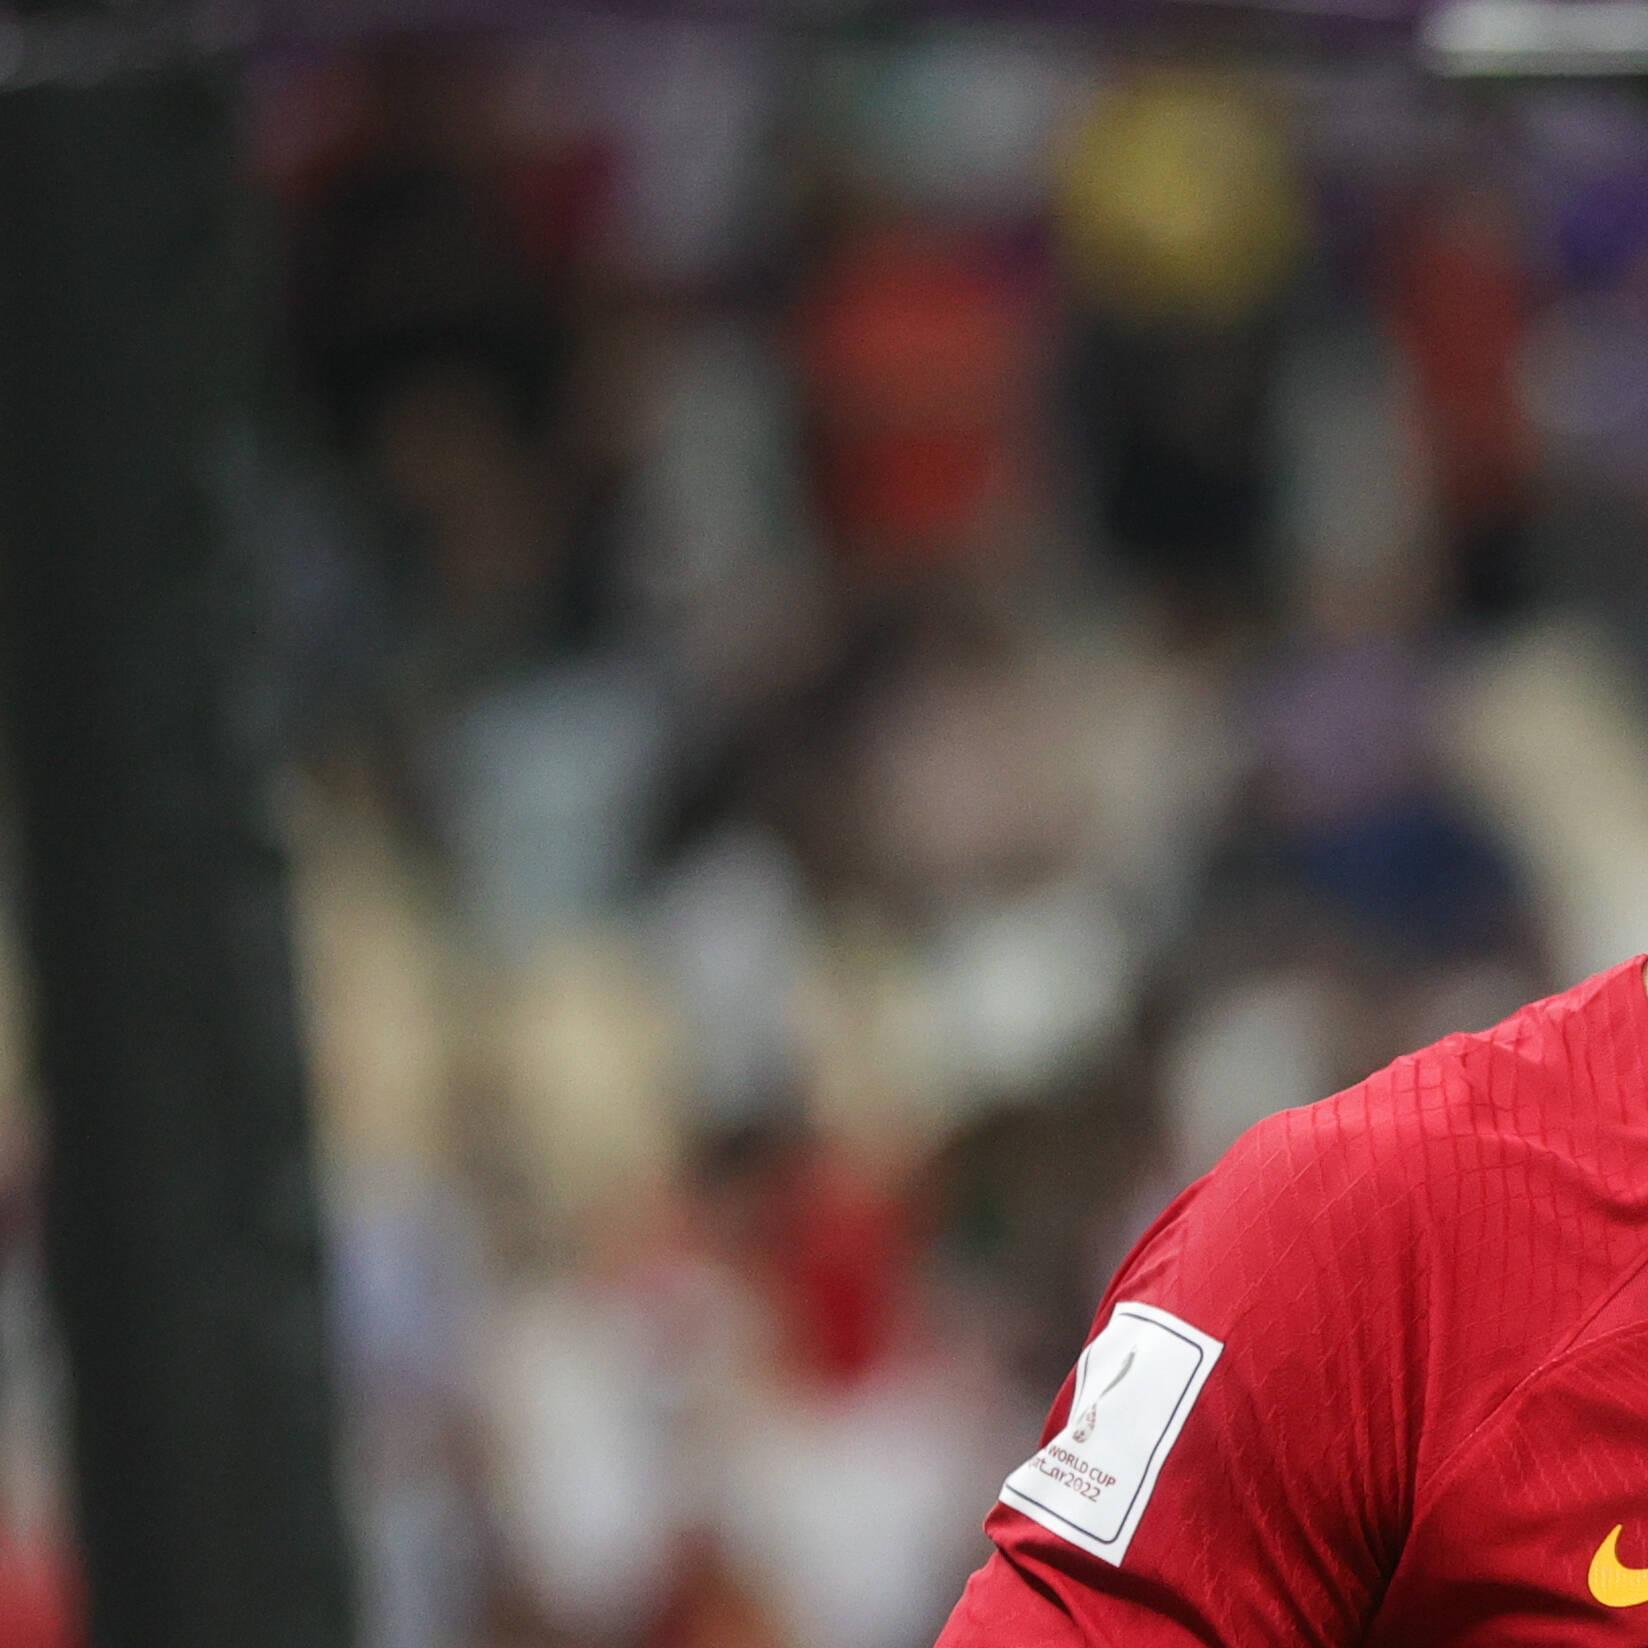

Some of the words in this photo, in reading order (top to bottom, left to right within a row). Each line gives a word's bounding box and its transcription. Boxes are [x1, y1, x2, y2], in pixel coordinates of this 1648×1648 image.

[1028, 1456, 1101, 1503] atar2022
[1048, 1445, 1089, 1474] WORLD
[1089, 1467, 1116, 1487] CUP
